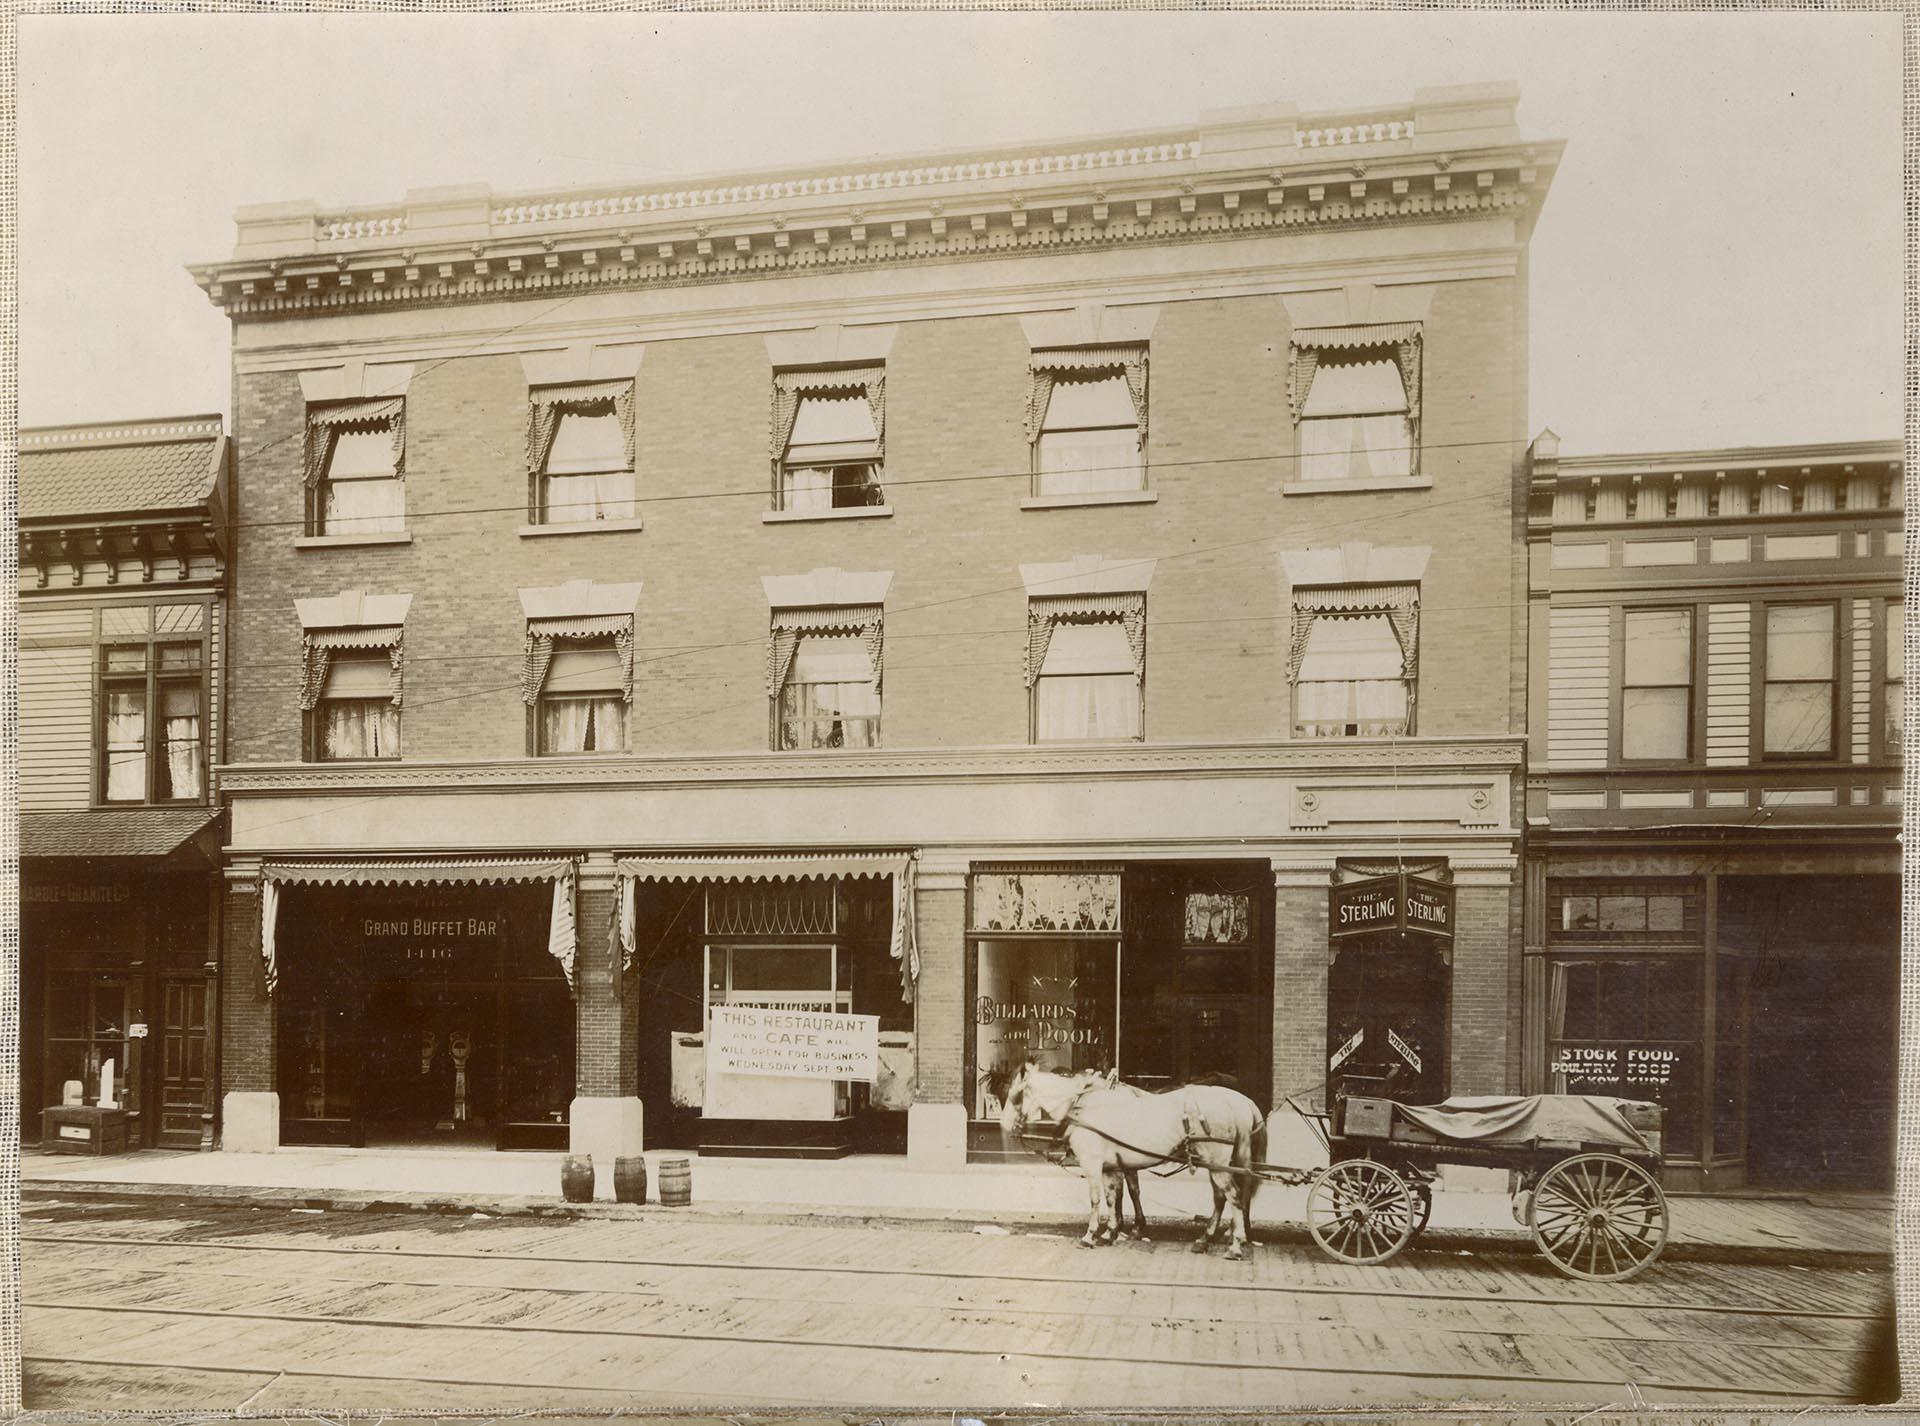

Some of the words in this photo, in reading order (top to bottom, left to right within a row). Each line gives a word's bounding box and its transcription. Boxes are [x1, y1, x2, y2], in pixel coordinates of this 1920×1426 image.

[1340, 897, 1395, 924] STERLING
[1407, 897, 1446, 924] STERLING
[364, 918, 408, 937] GRAND
[413, 918, 463, 936] BUFFET
[467, 917, 497, 936] BAR
[976, 995, 1077, 1026] BILLIARDS
[721, 1012, 758, 1027] THIS
[763, 1014, 867, 1034] RESTAURANT
[732, 1032, 757, 1041] AND
[764, 1032, 818, 1047] CAFE
[1003, 1026, 1031, 1041] and
[1036, 1021, 1103, 1050] POOL
[720, 1046, 745, 1056] WILL
[750, 1047, 782, 1057] OPEN
[787, 1049, 809, 1059] FOR
[815, 1051, 869, 1062] BUSINESS
[1627, 1049, 1680, 1062] FOOD.
[728, 1060, 799, 1072] WEDNESDAY
[1551, 1061, 1616, 1074] POULTRY
[1627, 1063, 1671, 1075] FOOD
